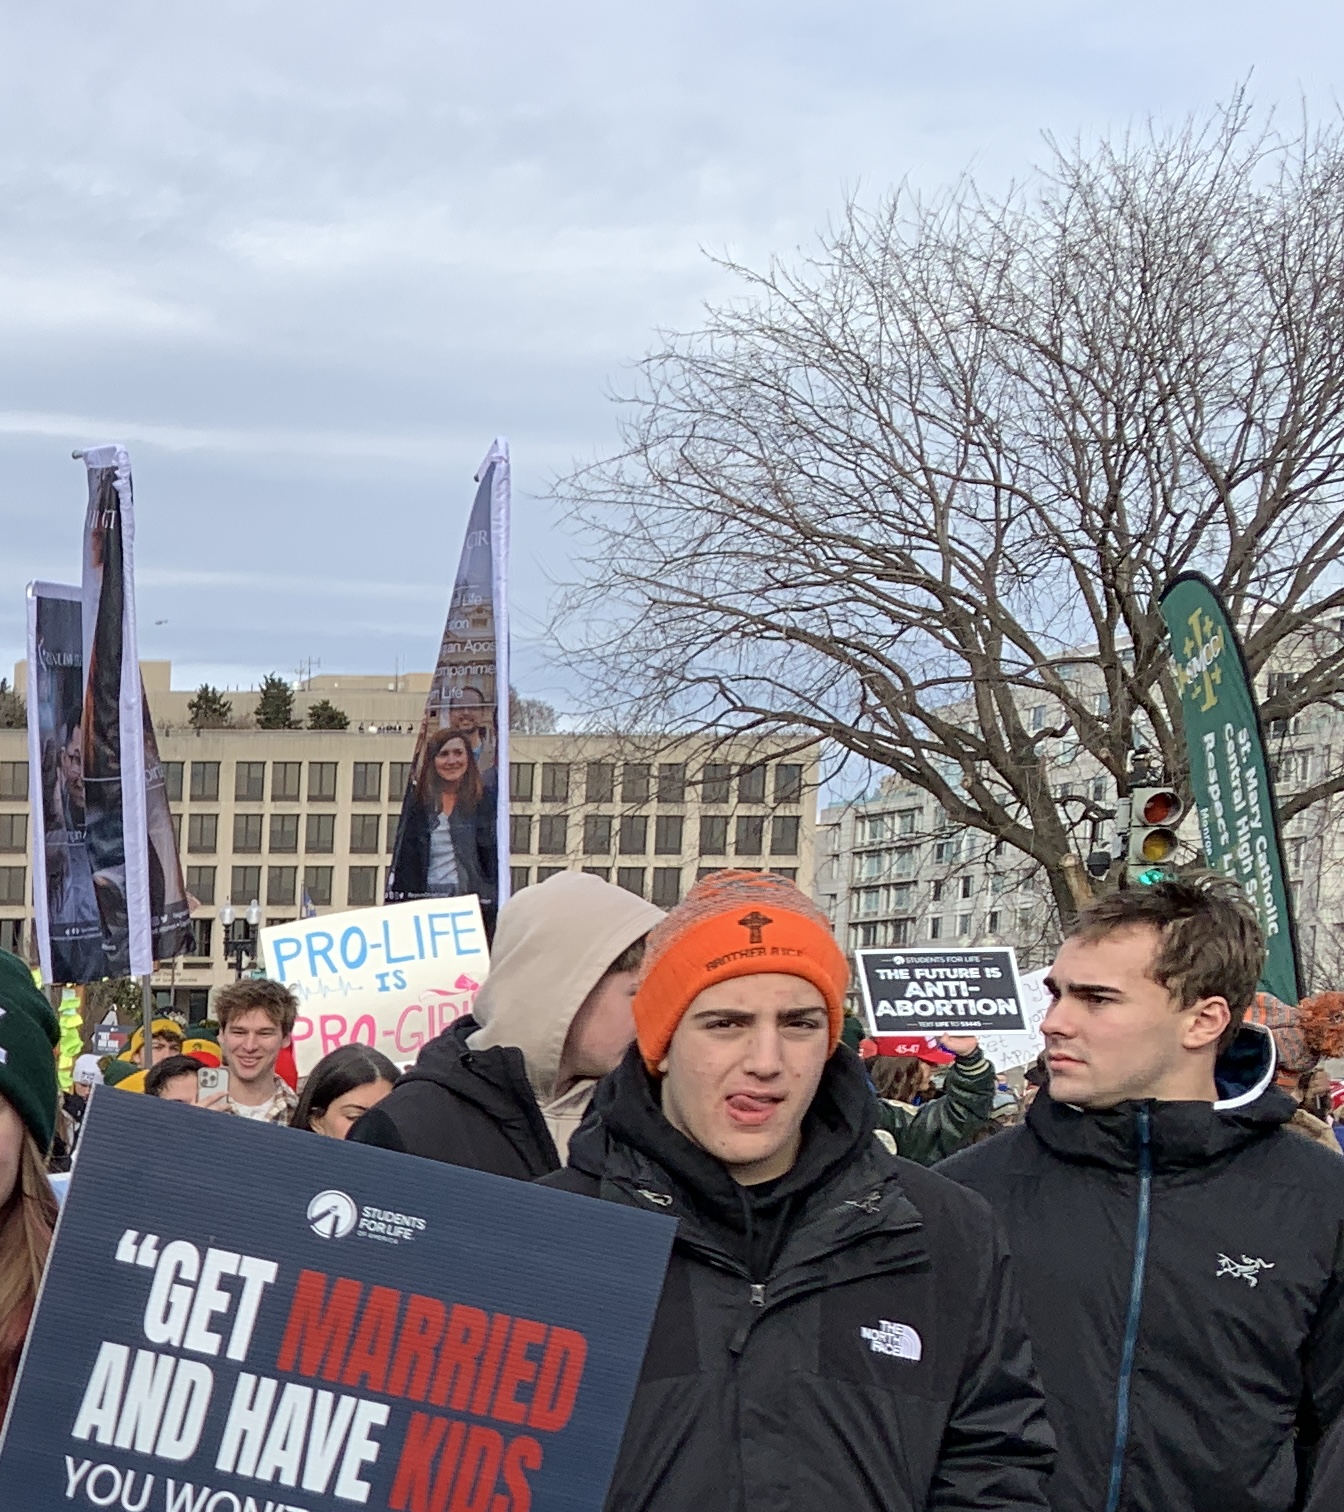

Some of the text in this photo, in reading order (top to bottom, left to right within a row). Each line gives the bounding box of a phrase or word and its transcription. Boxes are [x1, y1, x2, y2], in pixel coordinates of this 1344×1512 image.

[1203, 732, 1230, 846] Respect
[1225, 723, 1247, 812] Central
[1236, 815, 1254, 874] High
[1245, 766, 1262, 828] Mary
[1256, 836, 1279, 936] Catholic
[272, 911, 481, 982] PRO-LIFE
[906, 956, 945, 964] STUDENTS
[961, 955, 980, 963] LIFE
[375, 969, 407, 992] IS
[875, 967, 1002, 980] THE FUTURE IS
[905, 981, 980, 998] ANTI-
[875, 998, 1018, 1017] ABORTION
[291, 1000, 470, 1058] PRO-GIR
[895, 1044, 920, 1054] 45-47
[358, 1217, 415, 1241] FOR LIFE
[362, 1206, 427, 1231] STUDENTS
[860, 1326, 902, 1347] NORTH
[878, 1320, 904, 1334] THE
[277, 1269, 589, 1433] MARRIED
[870, 1340, 903, 1356] FACE
[71, 1341, 213, 1462] AND
[216, 1372, 391, 1503] HAVE
